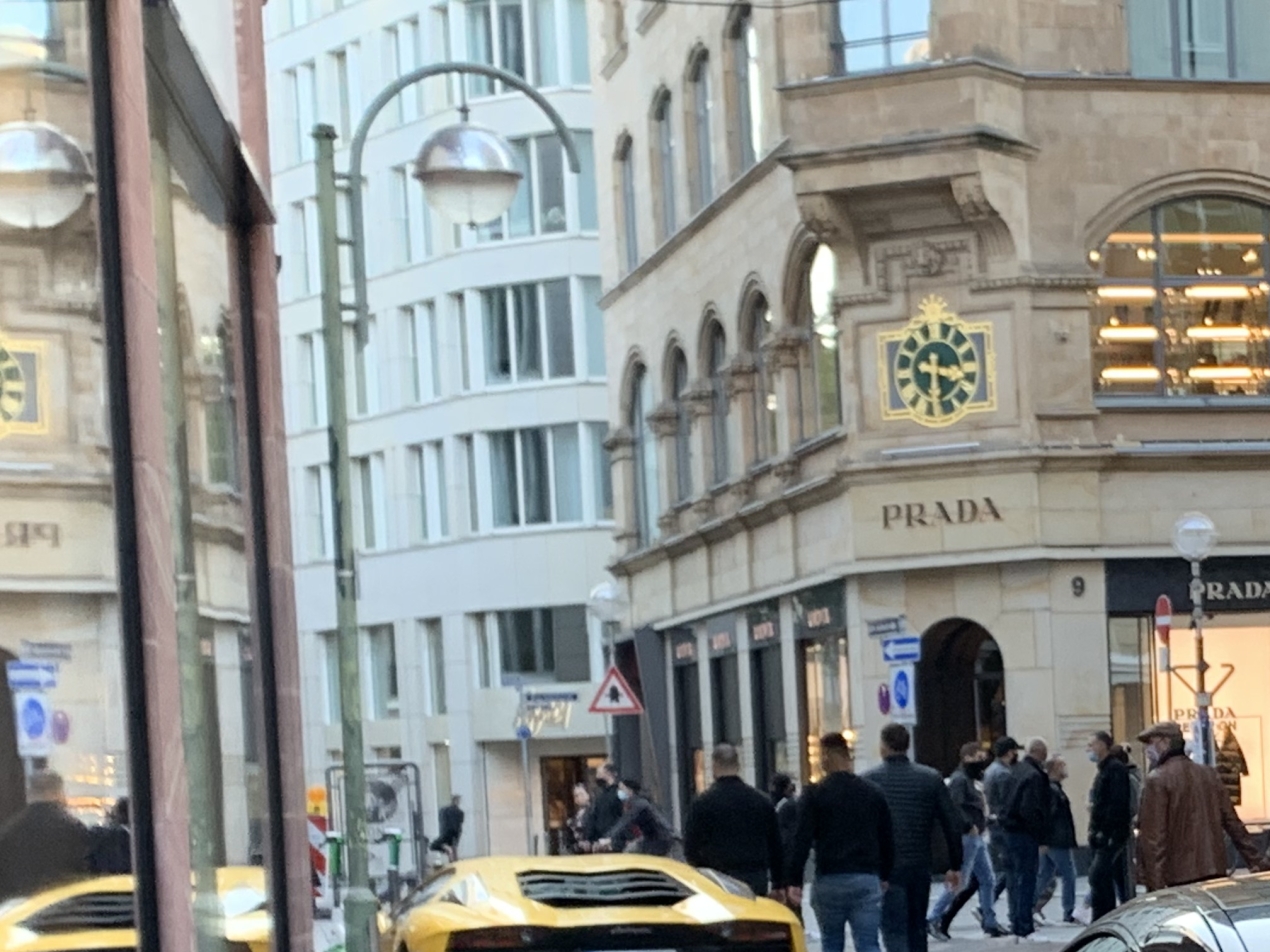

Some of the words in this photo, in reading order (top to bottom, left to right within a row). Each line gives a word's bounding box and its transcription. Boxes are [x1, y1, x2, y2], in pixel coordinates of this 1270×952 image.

[882, 497, 1003, 530] PRADA
[1071, 576, 1085, 597] 9
[1173, 706, 1237, 721] PRDA
